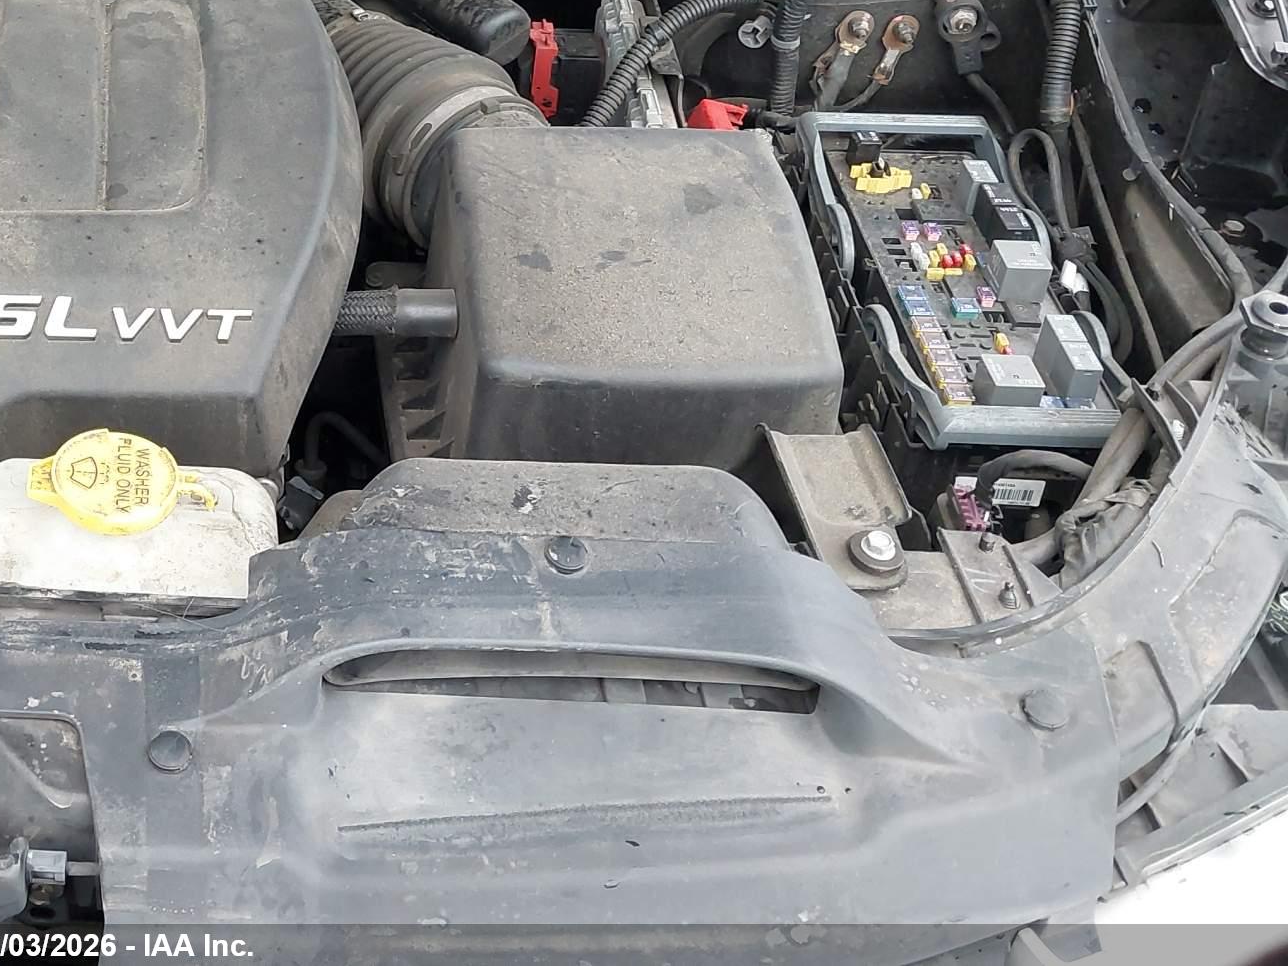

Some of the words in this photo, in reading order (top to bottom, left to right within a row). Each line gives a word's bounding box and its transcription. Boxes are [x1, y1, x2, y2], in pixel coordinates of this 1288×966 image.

[112, 307, 253, 342] VVT
[117, 437, 132, 475] FLUID
[135, 448, 150, 506] WASHER
[116, 479, 131, 514] ONLY
